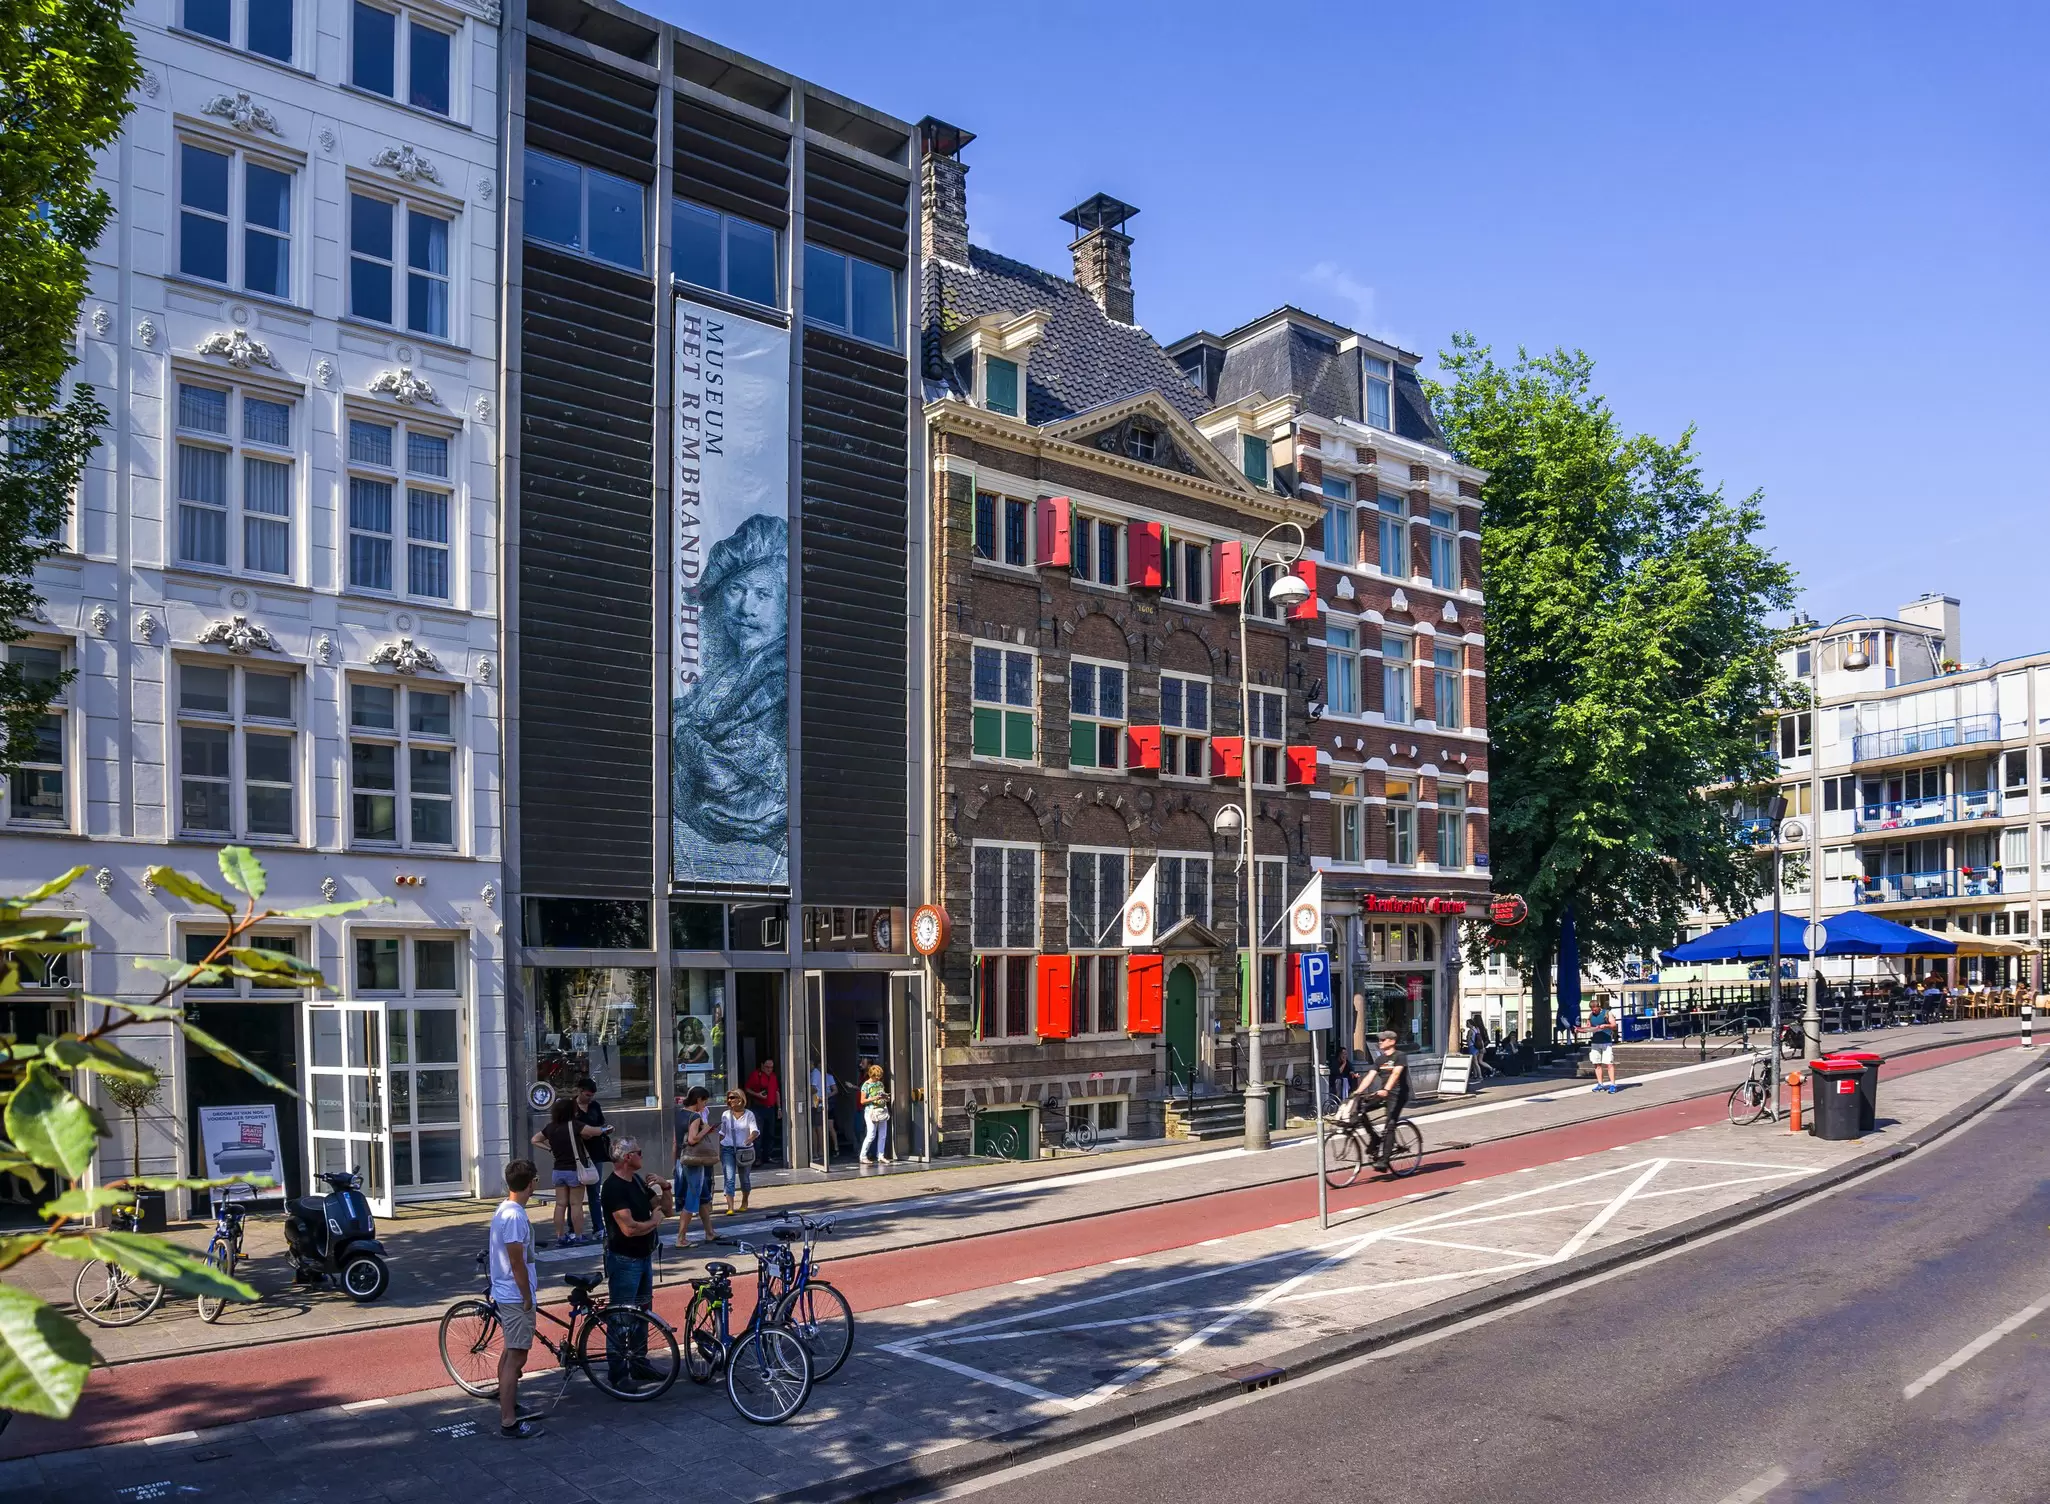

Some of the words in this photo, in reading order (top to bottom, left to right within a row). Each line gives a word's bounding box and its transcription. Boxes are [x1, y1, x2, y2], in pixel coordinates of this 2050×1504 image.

[682, 312, 701, 380] HET
[705, 318, 724, 457] MUSEUM
[1308, 957, 1324, 986] P
